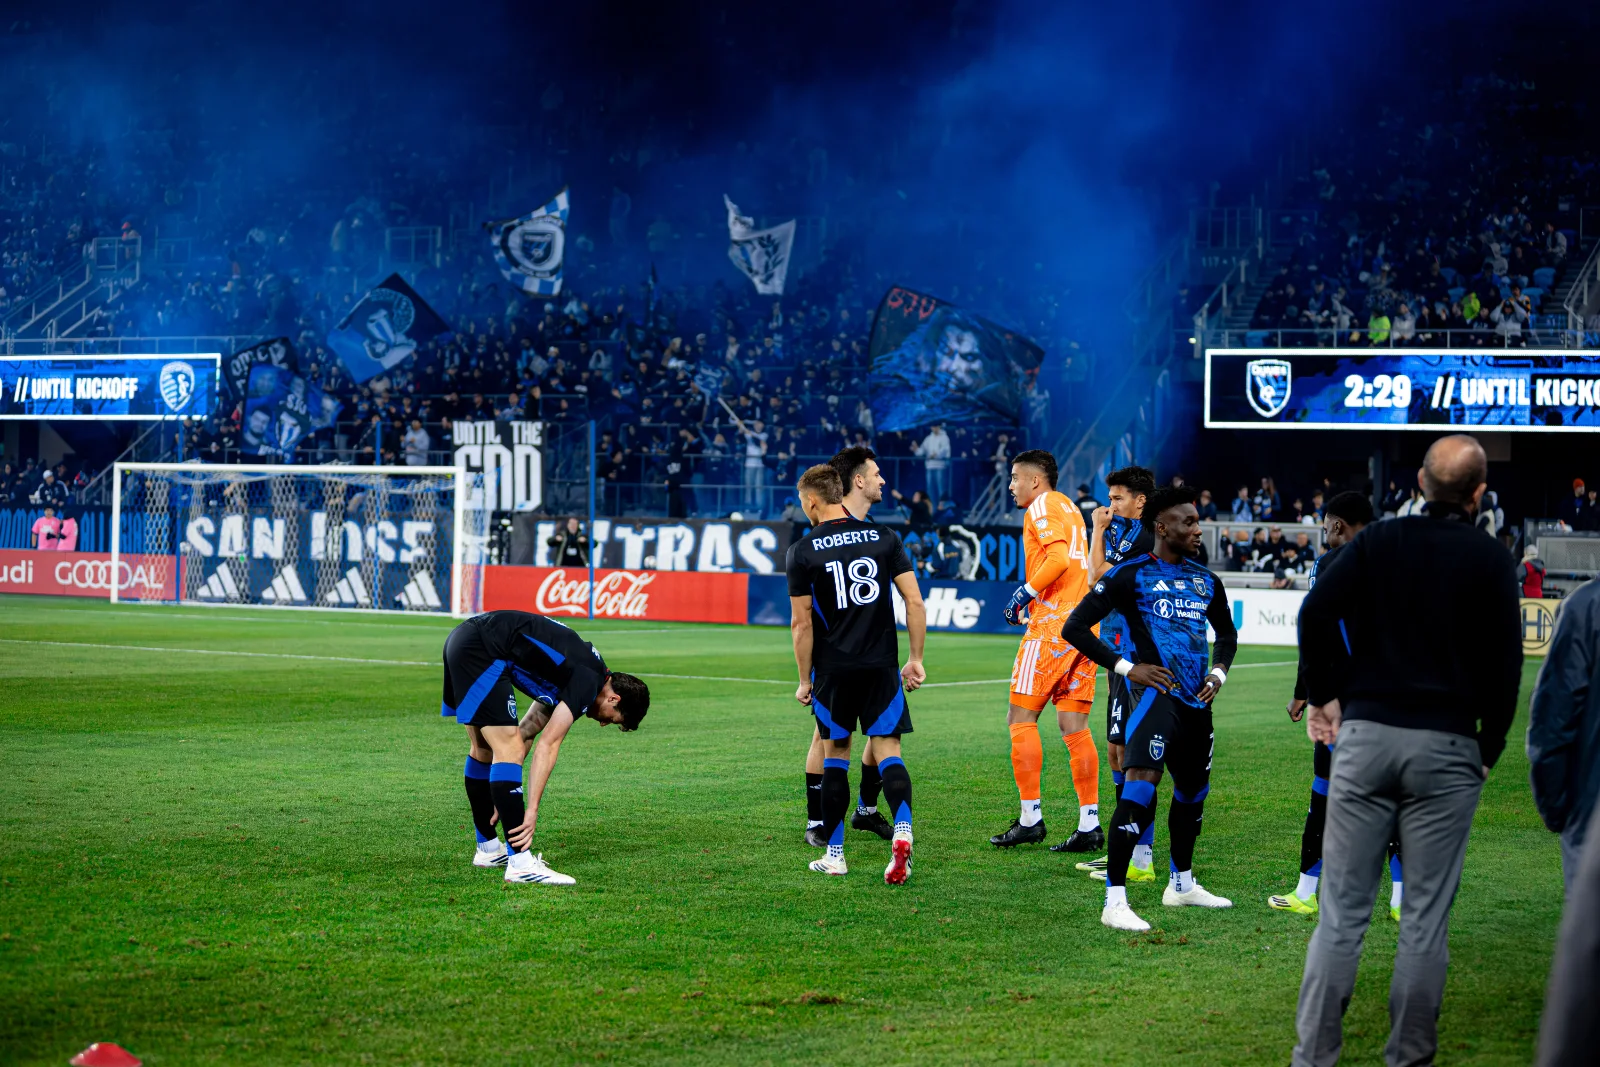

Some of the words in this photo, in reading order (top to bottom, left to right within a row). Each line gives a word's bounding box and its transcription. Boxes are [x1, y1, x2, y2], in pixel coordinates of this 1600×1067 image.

[31, 377, 74, 400] UNTIL
[75, 377, 139, 400] KICKOFF
[1344, 374, 1412, 408] 2:29
[1460, 378, 1531, 406] UNTIL
[453, 421, 500, 445] UNTIL
[510, 421, 543, 444] THE
[186, 513, 286, 560] SAN
[812, 529, 880, 551] ROBERTS
[825, 556, 880, 610] 18
[1174, 598, 1183, 608] El
[1175, 609, 1201, 620] Health
[1258, 609, 1286, 627] Not
